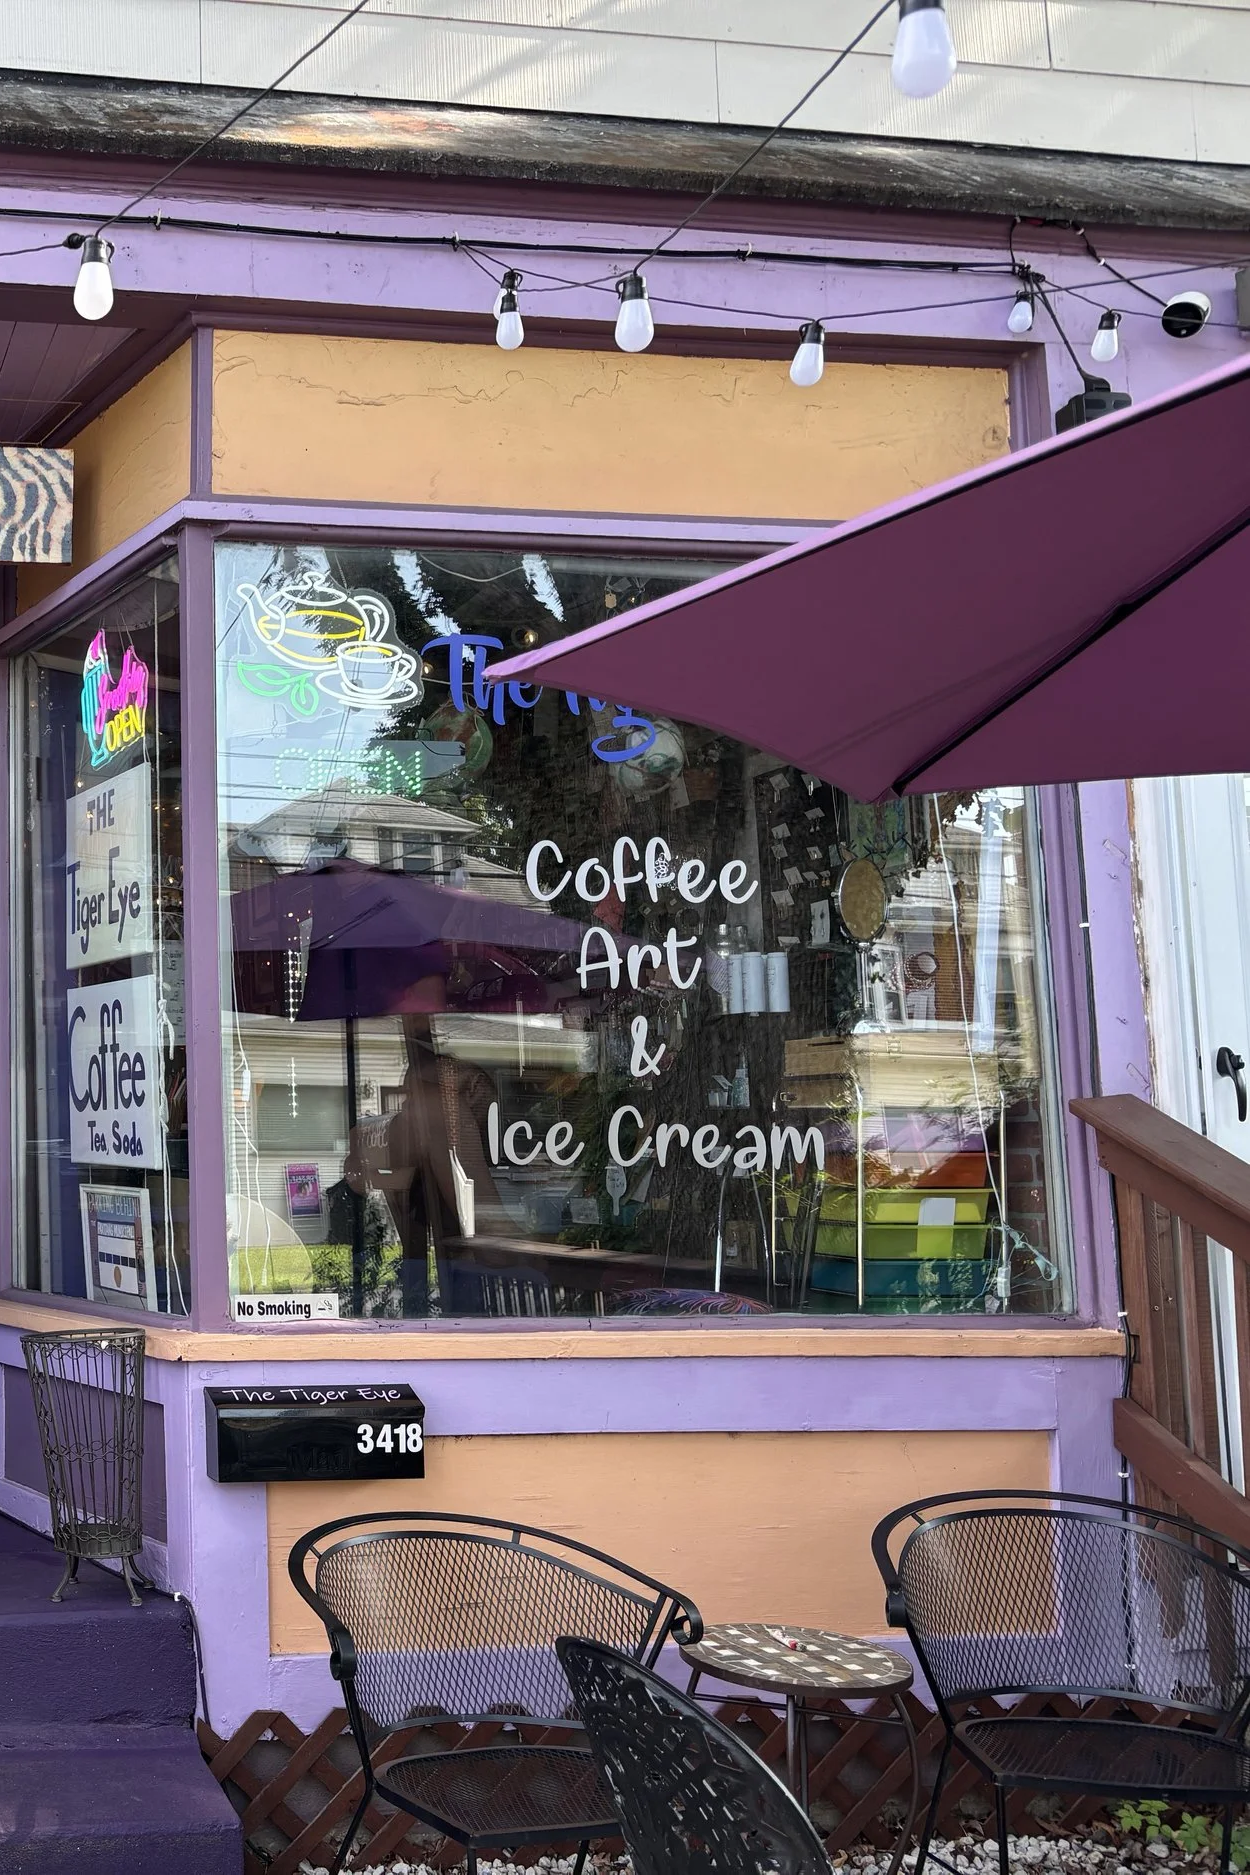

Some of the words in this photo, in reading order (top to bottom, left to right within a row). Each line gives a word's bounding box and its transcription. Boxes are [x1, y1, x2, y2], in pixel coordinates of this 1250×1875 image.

[106, 704, 143, 752] OPEN
[275, 747, 422, 795] OPEN
[87, 788, 115, 836] THE
[526, 836, 759, 904] Coffee
[67, 861, 105, 955] Tiger
[108, 846, 141, 943] Eye
[576, 926, 703, 990] Art
[68, 999, 146, 1113] Coffee
[630, 1015, 666, 1077] &
[112, 1119, 144, 1157] Soda
[488, 1101, 585, 1166] Ice
[608, 1105, 825, 1171] Cream
[237, 1301, 254, 1316] No
[257, 1300, 311, 1318] Smoking
[222, 1389, 275, 1402] The
[280, 1389, 349, 1405] Tiger
[356, 1387, 401, 1402] Eye
[357, 1423, 423, 1454] 3418
